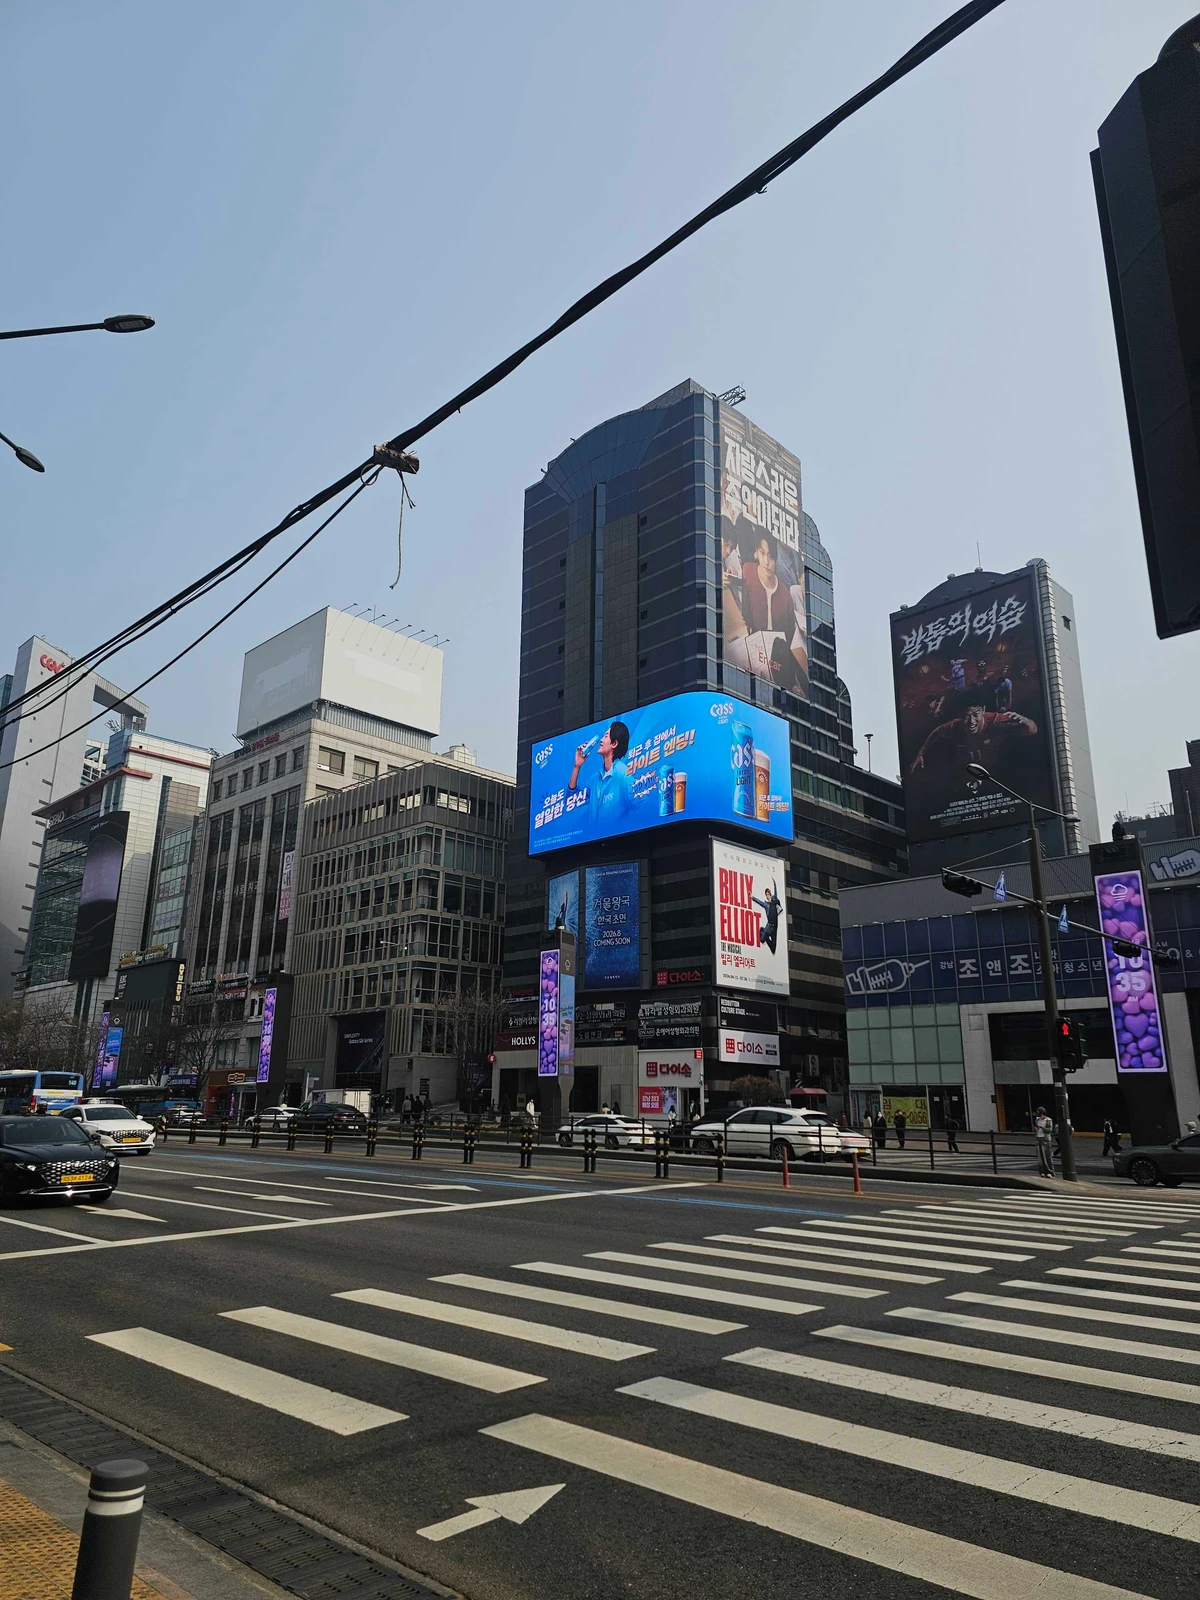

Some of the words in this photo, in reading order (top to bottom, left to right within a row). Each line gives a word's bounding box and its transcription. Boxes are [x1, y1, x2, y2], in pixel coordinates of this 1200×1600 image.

[724, 434, 799, 517] 자랑스러운
[725, 472, 800, 553] 주인이돼라
[900, 602, 972, 667] 발톱의
[972, 594, 1028, 644] 역습
[627, 743, 644, 760] 퇴근
[643, 738, 653, 752] 후
[653, 724, 677, 746] 집에서
[625, 744, 661, 777] 라이트
[542, 788, 566, 810] 오늘도
[534, 801, 565, 830] 열일한
[566, 787, 589, 813] 당신
[718, 866, 754, 910] BILLY
[593, 894, 631, 912] 겨울왕국
[597, 914, 613, 926] 한국
[719, 903, 762, 948] ELLIOT
[593, 937, 616, 949] COMING
[615, 936, 632, 947] SOON
[720, 952, 733, 966] 빌리
[733, 955, 757, 969] 엘리어트
[939, 960, 954, 970] 강남
[669, 969, 702, 984] 다이소
[1115, 970, 1147, 992] 35
[544, 998, 556, 1012] 10
[543, 1012, 556, 1025] 35
[511, 1036, 536, 1046] HOLLYS
[737, 1041, 763, 1055] 다이소
[659, 1062, 692, 1075] 다이소
